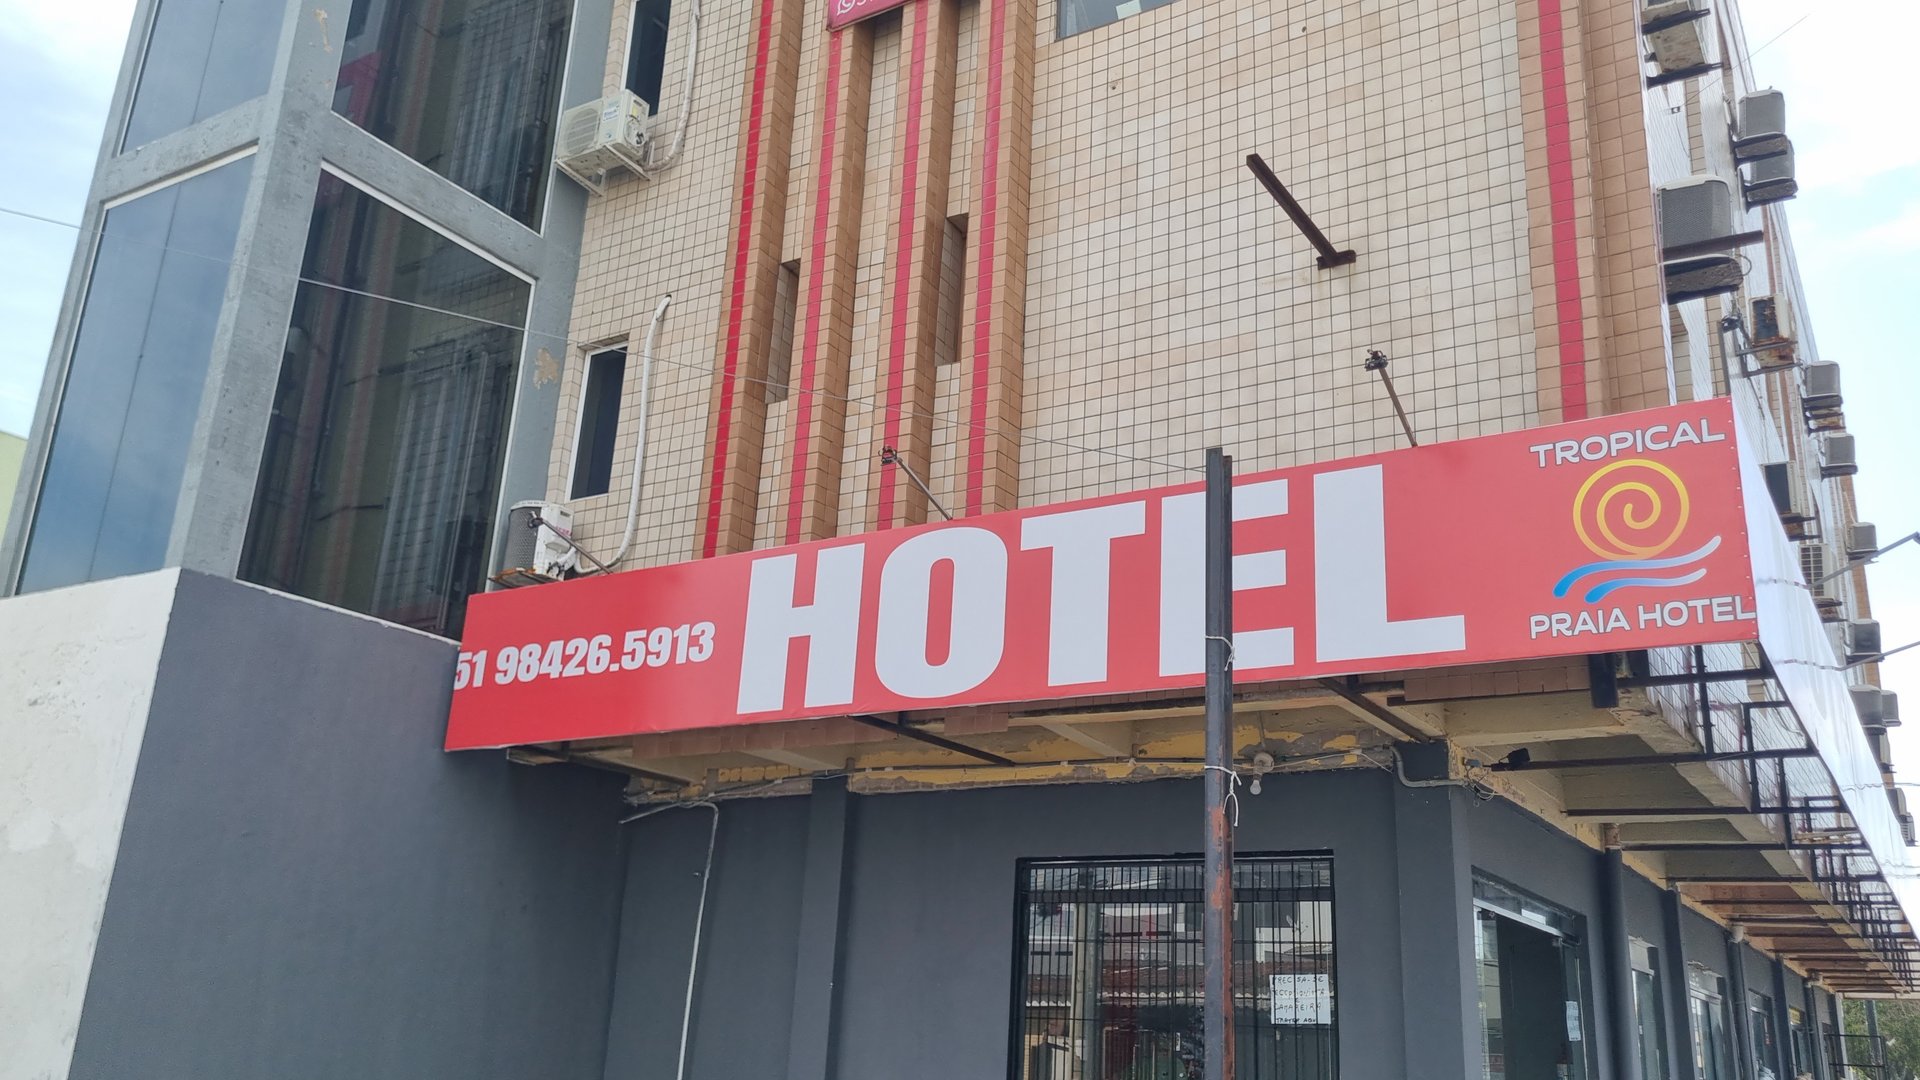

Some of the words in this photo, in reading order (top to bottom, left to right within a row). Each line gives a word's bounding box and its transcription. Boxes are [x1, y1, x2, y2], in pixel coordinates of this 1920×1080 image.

[1529, 418, 1726, 468] TROPICAL
[737, 463, 1466, 714] HOTEL
[1530, 607, 1631, 640] PRAIA
[1638, 595, 1757, 630] HOTEL
[454, 649, 488, 691] 51
[494, 621, 716, 685] 98426.5913
